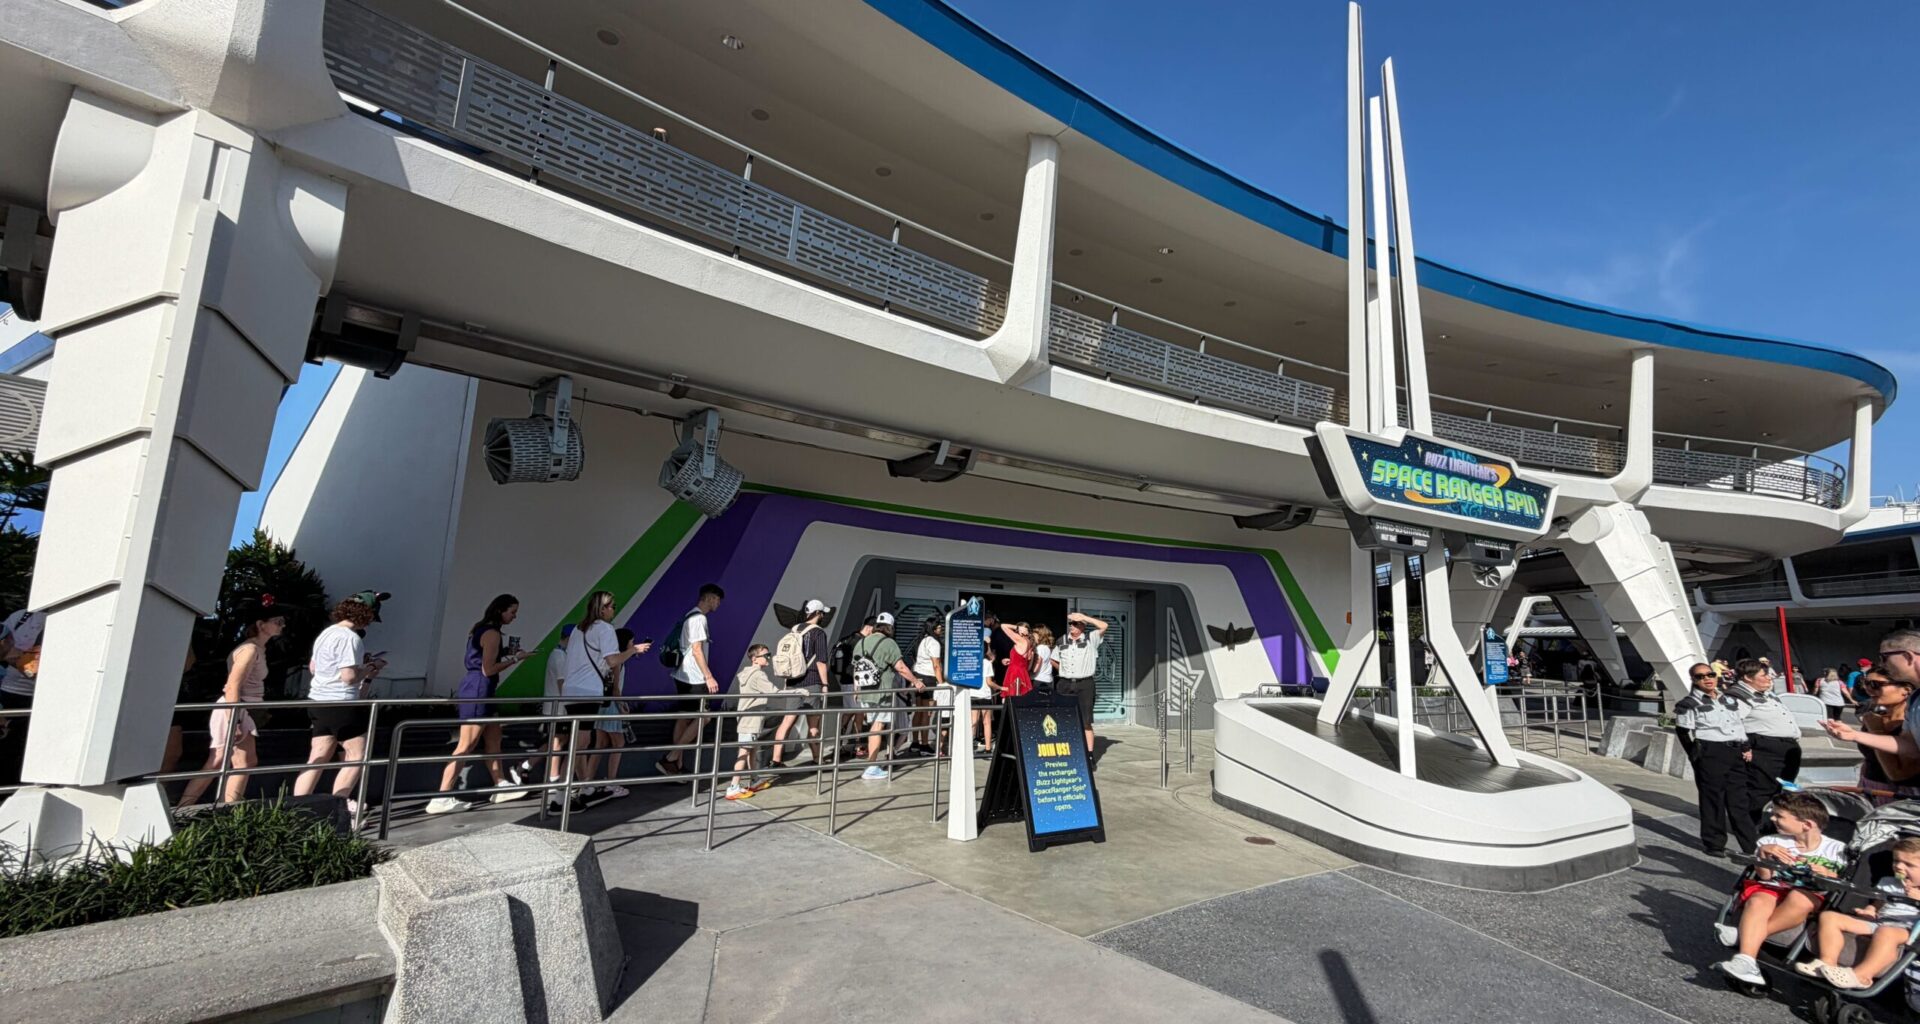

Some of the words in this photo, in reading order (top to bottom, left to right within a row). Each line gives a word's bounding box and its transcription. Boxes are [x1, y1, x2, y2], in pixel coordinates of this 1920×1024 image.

[1424, 451, 1448, 469] BUZZ
[1371, 459, 1434, 493] SPACE
[1436, 473, 1504, 512] RANGER
[1505, 490, 1540, 518] SPIN
[1038, 743, 1056, 757] JOIN
[1056, 742, 1071, 756] US!
[1052, 777, 1082, 785] Lightyear's
